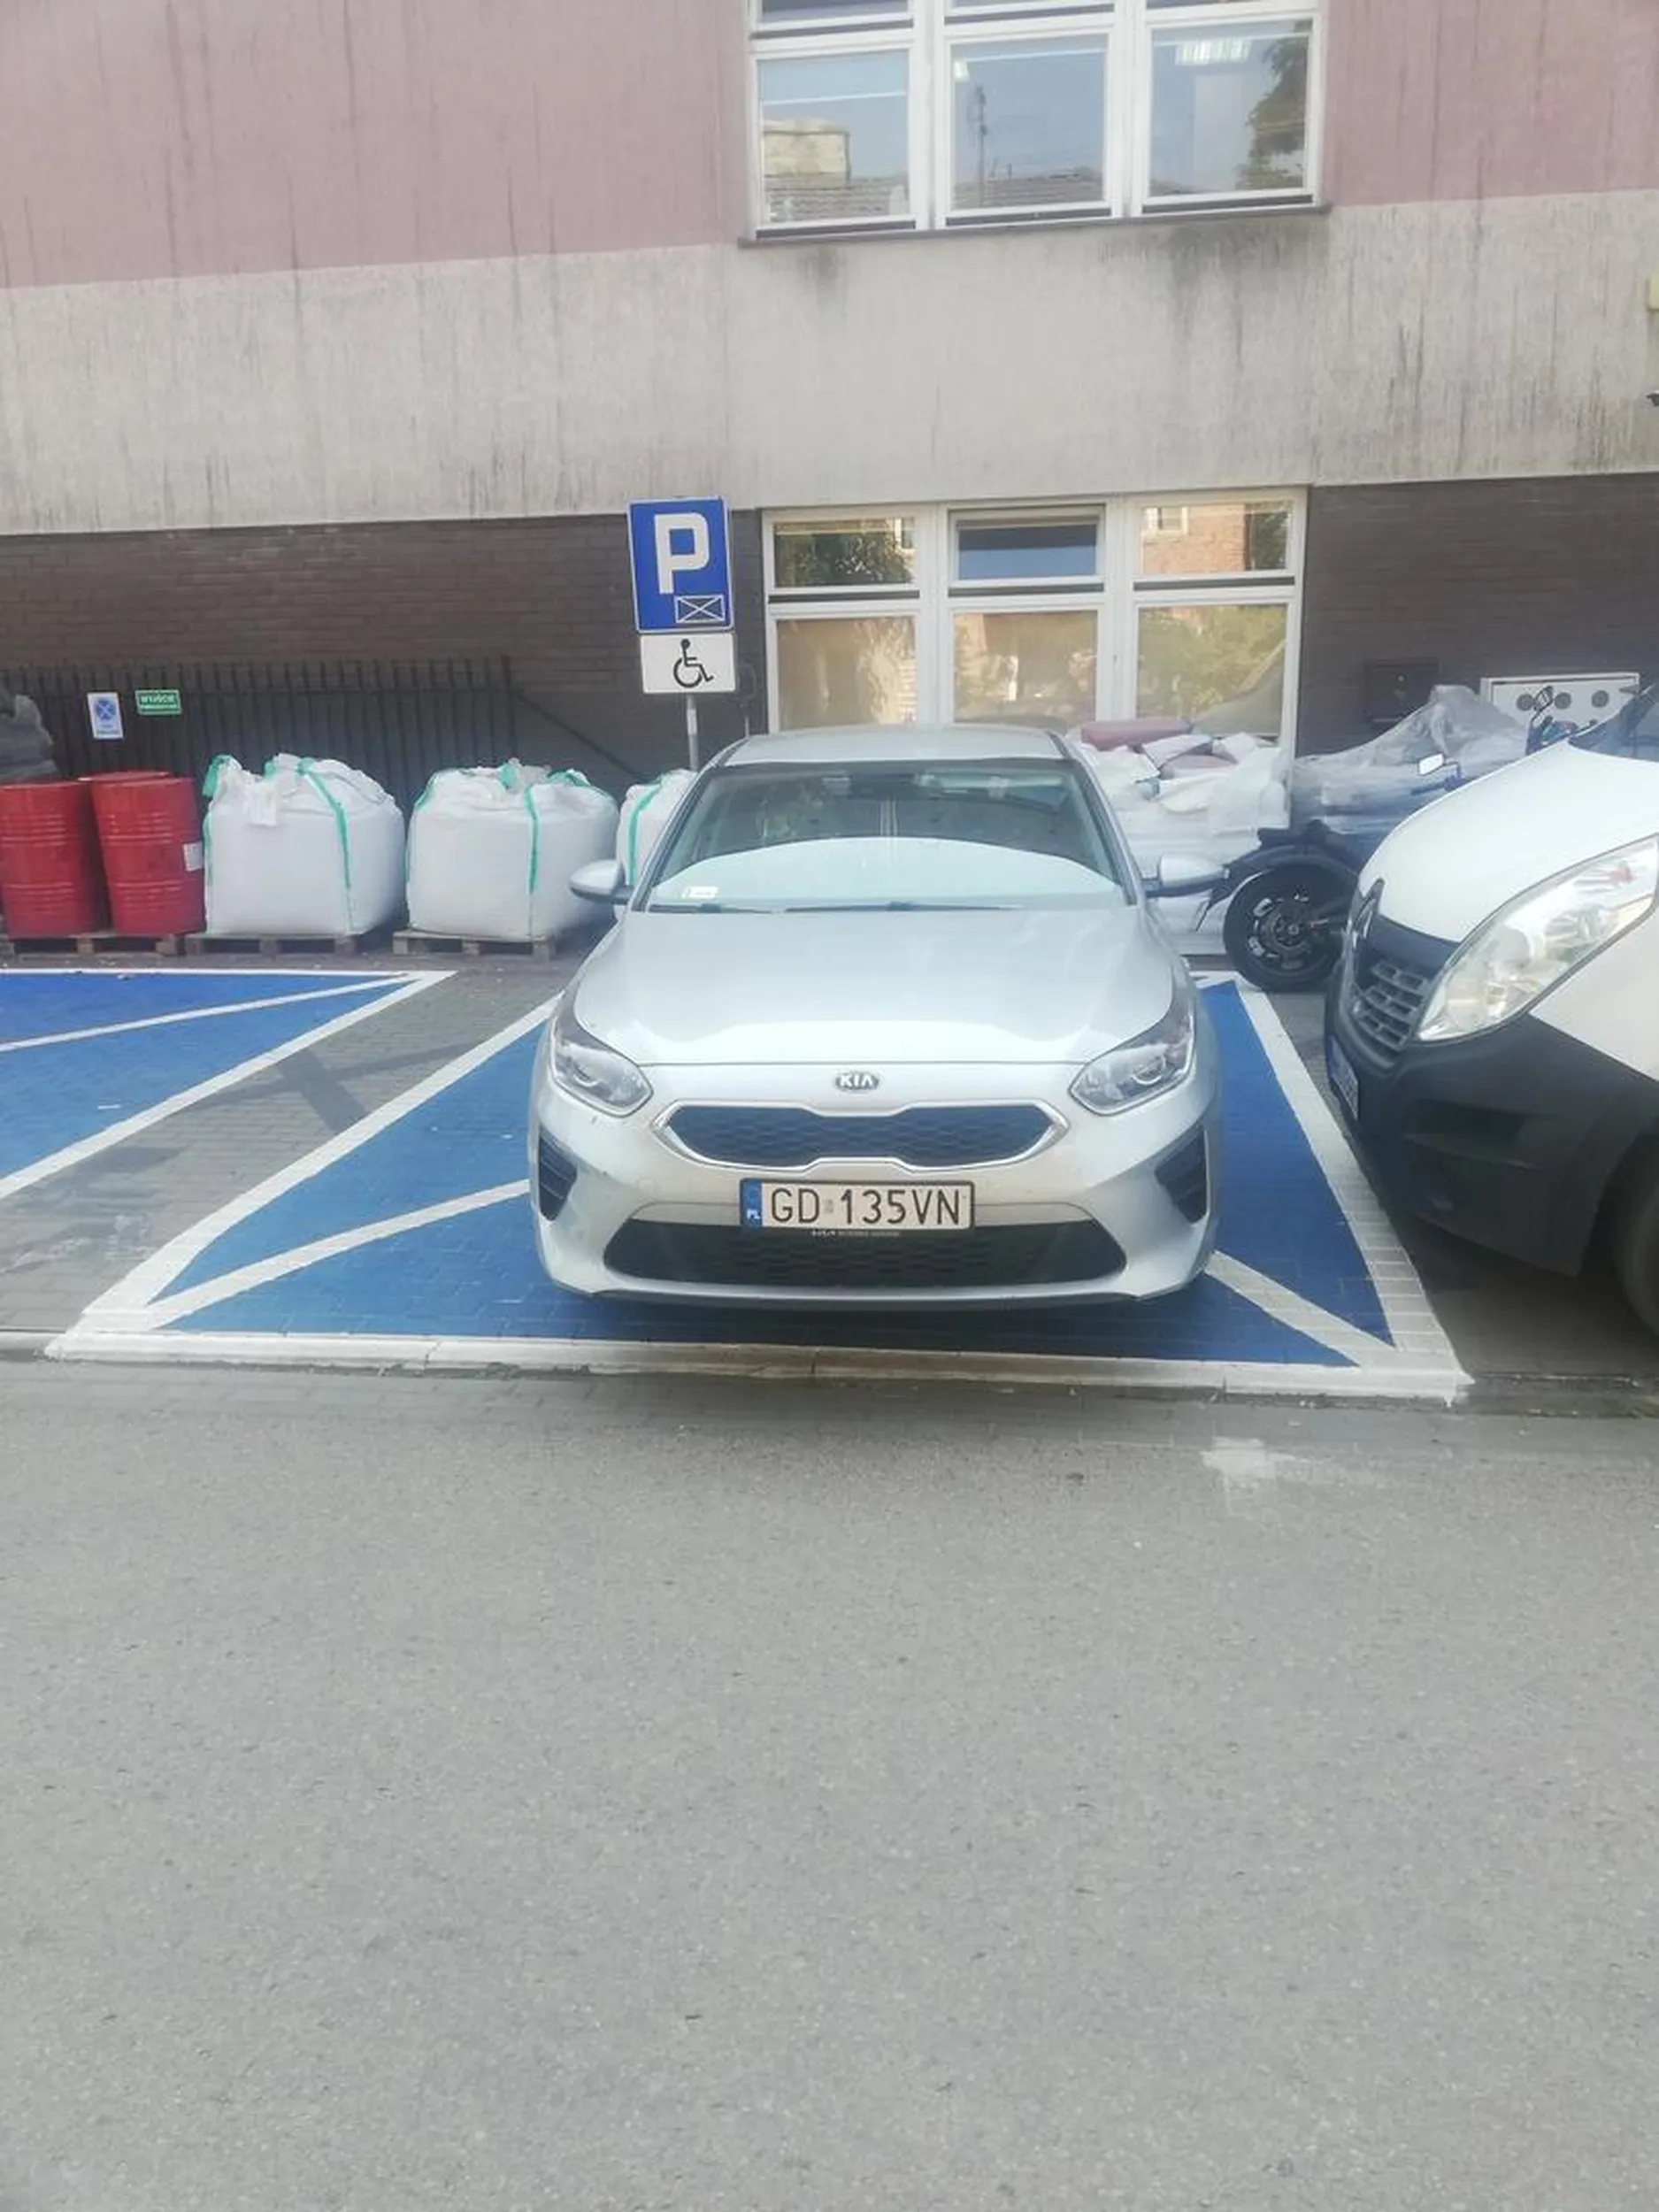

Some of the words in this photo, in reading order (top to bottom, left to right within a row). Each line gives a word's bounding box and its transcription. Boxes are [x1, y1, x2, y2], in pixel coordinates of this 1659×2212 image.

[655, 513, 710, 595] P
[841, 1074, 873, 1087] KIA
[772, 1187, 820, 1224] GD
[841, 1188, 960, 1225] 135VN
